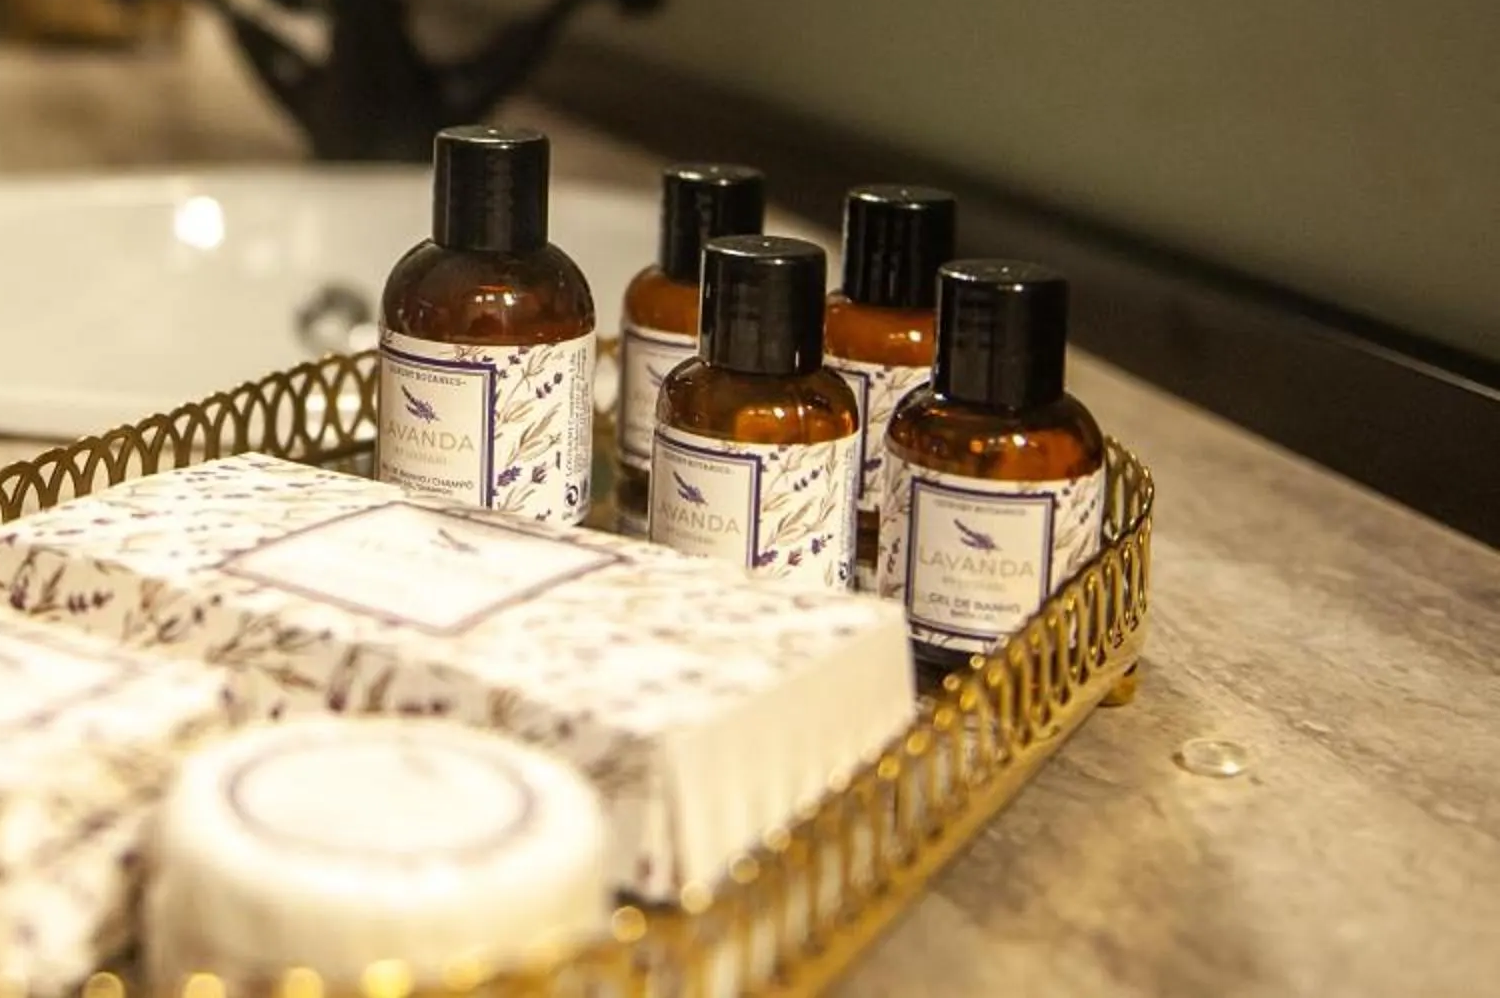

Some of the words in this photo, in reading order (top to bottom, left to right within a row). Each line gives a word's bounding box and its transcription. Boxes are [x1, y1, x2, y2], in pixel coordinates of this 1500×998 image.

[386, 419, 475, 452] AVANDA
[657, 500, 741, 535] AVANDA
[920, 544, 1034, 577] LAVANDA
